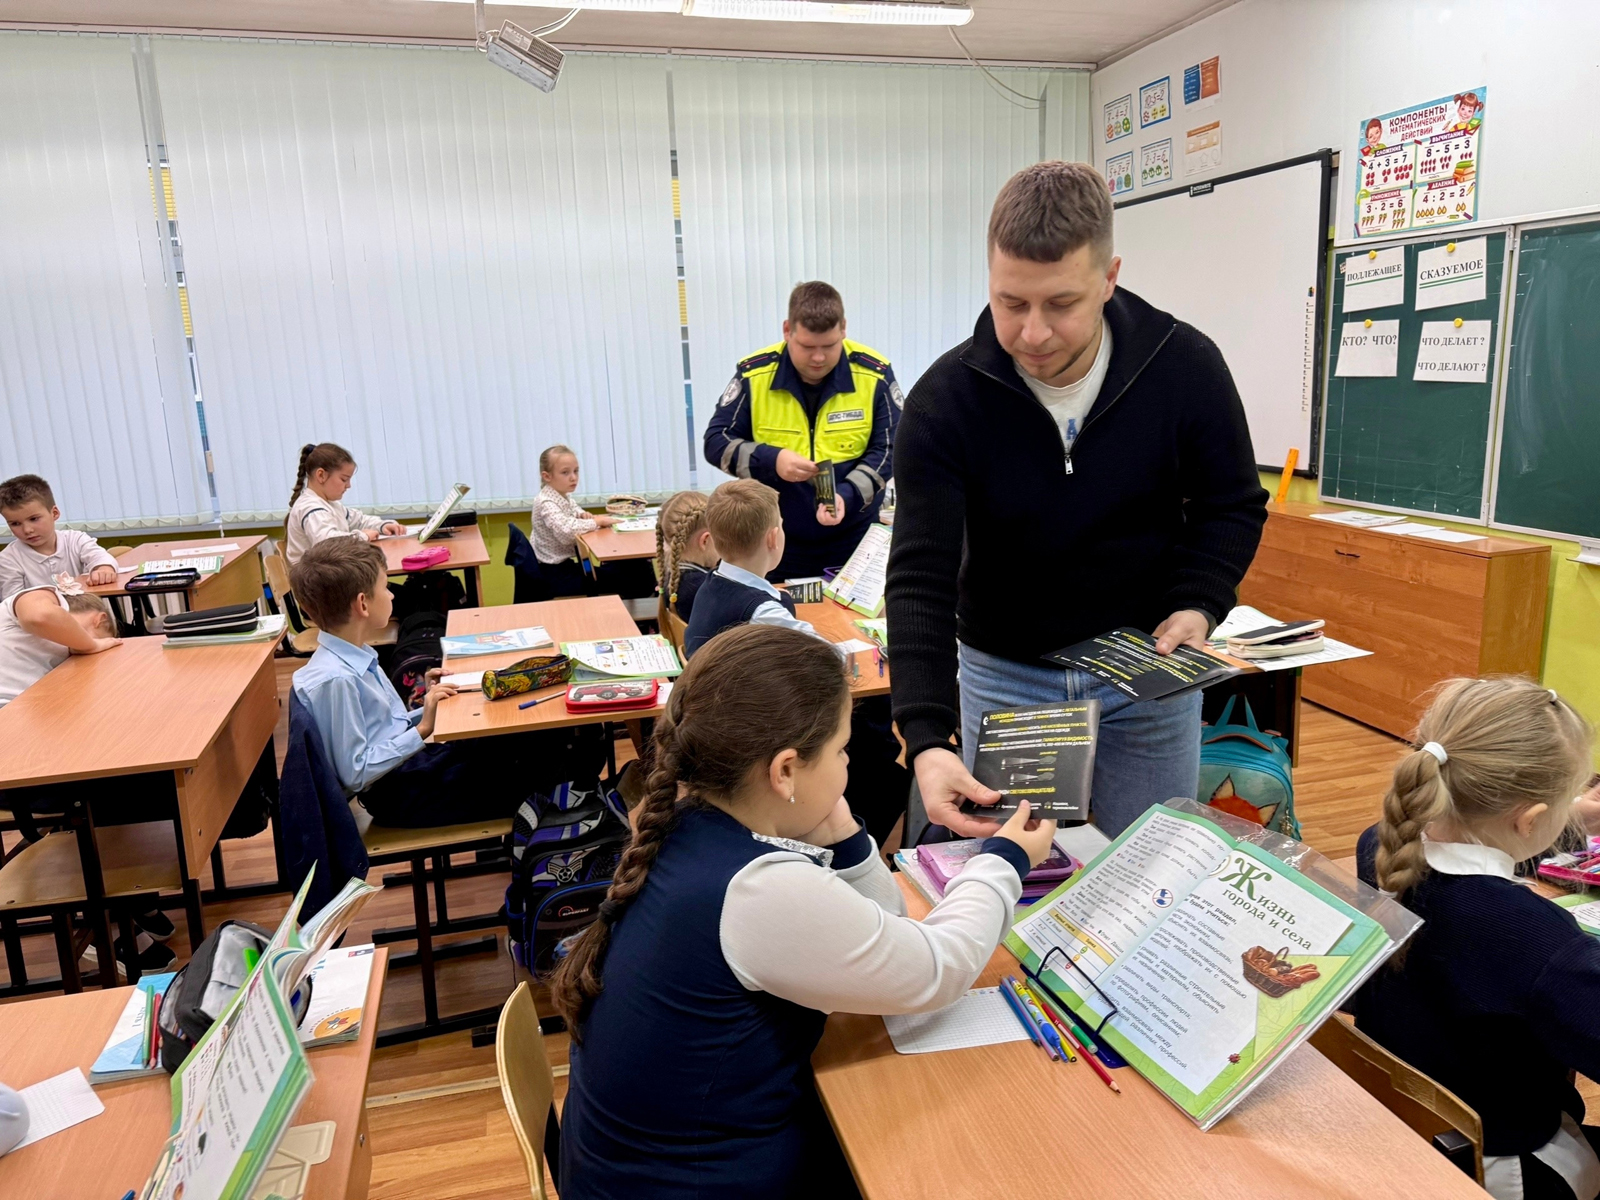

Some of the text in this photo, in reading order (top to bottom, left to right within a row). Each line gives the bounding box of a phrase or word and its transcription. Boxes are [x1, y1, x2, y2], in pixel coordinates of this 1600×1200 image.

[1390, 104, 1447, 126] КОМПОНЕНТЫ
[1390, 114, 1446, 134] МАТЕМАТИЧЕСКИХ
[1401, 126, 1433, 141] ДЕЙСТВИЙ
[1432, 131, 1464, 143] ВЫЧИТАНИЕ
[1376, 146, 1401, 156] СЛОЖЕНИЕ
[1427, 149, 1432, 157] 8
[1444, 145, 1450, 153] 5
[1464, 140, 1470, 149] 3
[1369, 162, 1373, 170] 4
[1385, 158, 1390, 166] 3
[1402, 154, 1407, 163] 7
[1432, 180, 1454, 188] ДЕЛЕНИЕ
[1423, 195, 1428, 203] 4
[1440, 192, 1445, 200] 2
[1460, 188, 1465, 197] 2
[1367, 205, 1371, 213] 3
[1381, 202, 1385, 211] 2
[1398, 199, 1403, 207] 6
[1347, 264, 1402, 281] ПОДЛЕЖАЩЕЕ
[1420, 259, 1483, 280] СКАЗУЕМОЕ
[1342, 335, 1397, 346] КТО? ЧТО?
[1422, 337, 1439, 345] ЧТО
[1441, 337, 1478, 347] ДЕЛАЕТ
[1437, 363, 1479, 372] ДЕЛАЮТ
[1214, 906, 1237, 925] раздел,
[1222, 889, 1311, 950] города и села
[1197, 920, 1225, 941] составные
[1197, 936, 1233, 964] взаимосвязь;
[1189, 947, 1239, 984] производственные
[1159, 958, 1187, 980] различные
[1188, 980, 1226, 1009] строительные
[1160, 967, 1190, 992] материалы,
[1192, 991, 1220, 1014] объяснять
[1220, 978, 1247, 999] помощью
[1145, 981, 1159, 993] виды
[1160, 993, 1192, 1019] транспорта;
[1116, 984, 1150, 1012] фотографиям,
[1151, 1011, 1181, 1037] описаниям;
[1139, 994, 1169, 1018] профессии
[1169, 1018, 1188, 1033] людей
[1121, 1005, 1154, 1033] взаимосвязи
[1154, 1032, 1172, 1049] между
[1130, 1021, 1158, 1044] различных
[1158, 1044, 1188, 1069] профессий.
